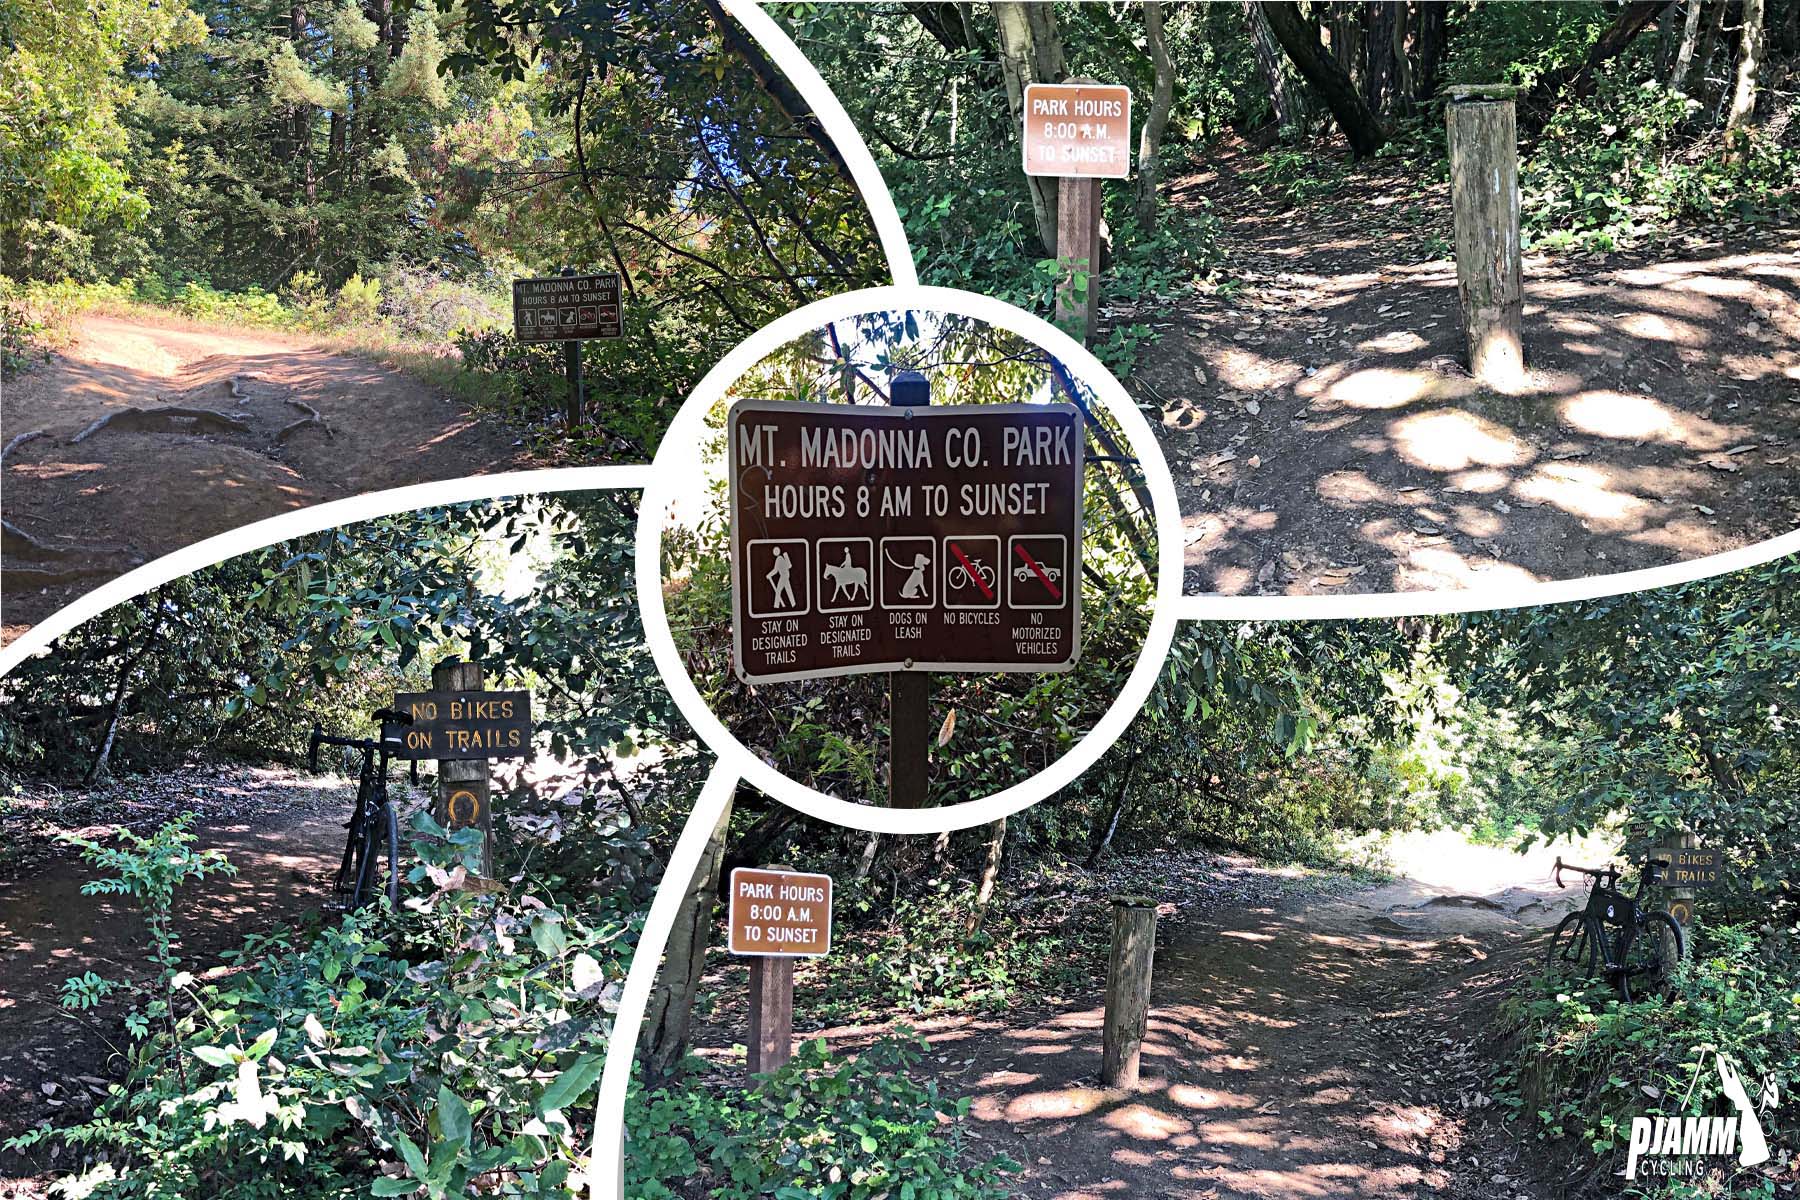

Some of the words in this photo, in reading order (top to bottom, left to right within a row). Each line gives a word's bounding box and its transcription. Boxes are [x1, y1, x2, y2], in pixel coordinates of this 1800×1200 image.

[1033, 99, 1068, 115] PARK
[1074, 100, 1122, 116] HOURS
[1044, 122, 1076, 138] 8:00
[1082, 124, 1110, 140] A.M.
[1038, 145, 1056, 160] TO
[1064, 145, 1115, 163] SUNSET
[516, 284, 530, 294] MT.
[533, 281, 574, 293] MADONNA
[578, 280, 592, 290] CO.
[596, 278, 617, 288] PARK
[522, 296, 547, 305] HOURS
[550, 296, 555, 304] 8
[558, 295, 568, 303] AM
[571, 294, 580, 302] TO
[582, 292, 610, 302] SUNSET
[740, 424, 786, 467] MT.
[801, 426, 932, 469] MADONNA
[945, 428, 988, 468] CO.
[1002, 426, 1071, 466] PARK
[764, 484, 845, 518] HOURS
[856, 486, 870, 518] 8
[880, 486, 911, 517] AM
[922, 484, 948, 516] TO
[960, 482, 1050, 516] SUNSET
[829, 616, 848, 628] STAY
[852, 614, 864, 627] ON
[890, 612, 912, 624] DOGS
[916, 612, 928, 624] ON
[944, 612, 956, 624] NO
[960, 612, 1000, 624] BICYCLES
[1030, 612, 1043, 624] NO
[762, 621, 782, 634] STAY
[786, 619, 798, 632] ON
[895, 626, 922, 639] LEASH
[1012, 628, 1061, 640] MOTORIZED
[752, 634, 808, 650] DESIGNATED
[820, 628, 872, 644] DESIGNATED
[832, 644, 860, 658] TRAILS
[1016, 642, 1058, 654] VEHICLES
[765, 650, 796, 664] TRAILS
[412, 702, 438, 720] NO
[450, 700, 514, 720] BIKES
[407, 731, 432, 750] ON
[445, 728, 520, 750] TRAILS
[1678, 854, 1712, 866] BIKES
[1674, 870, 1716, 882] TRAILS
[740, 882, 774, 899] PARK
[780, 885, 824, 902] HOURS
[750, 904, 782, 920] 8:00
[786, 906, 813, 922] A.M.
[744, 926, 761, 941] TO
[766, 926, 818, 944] SUNSET
